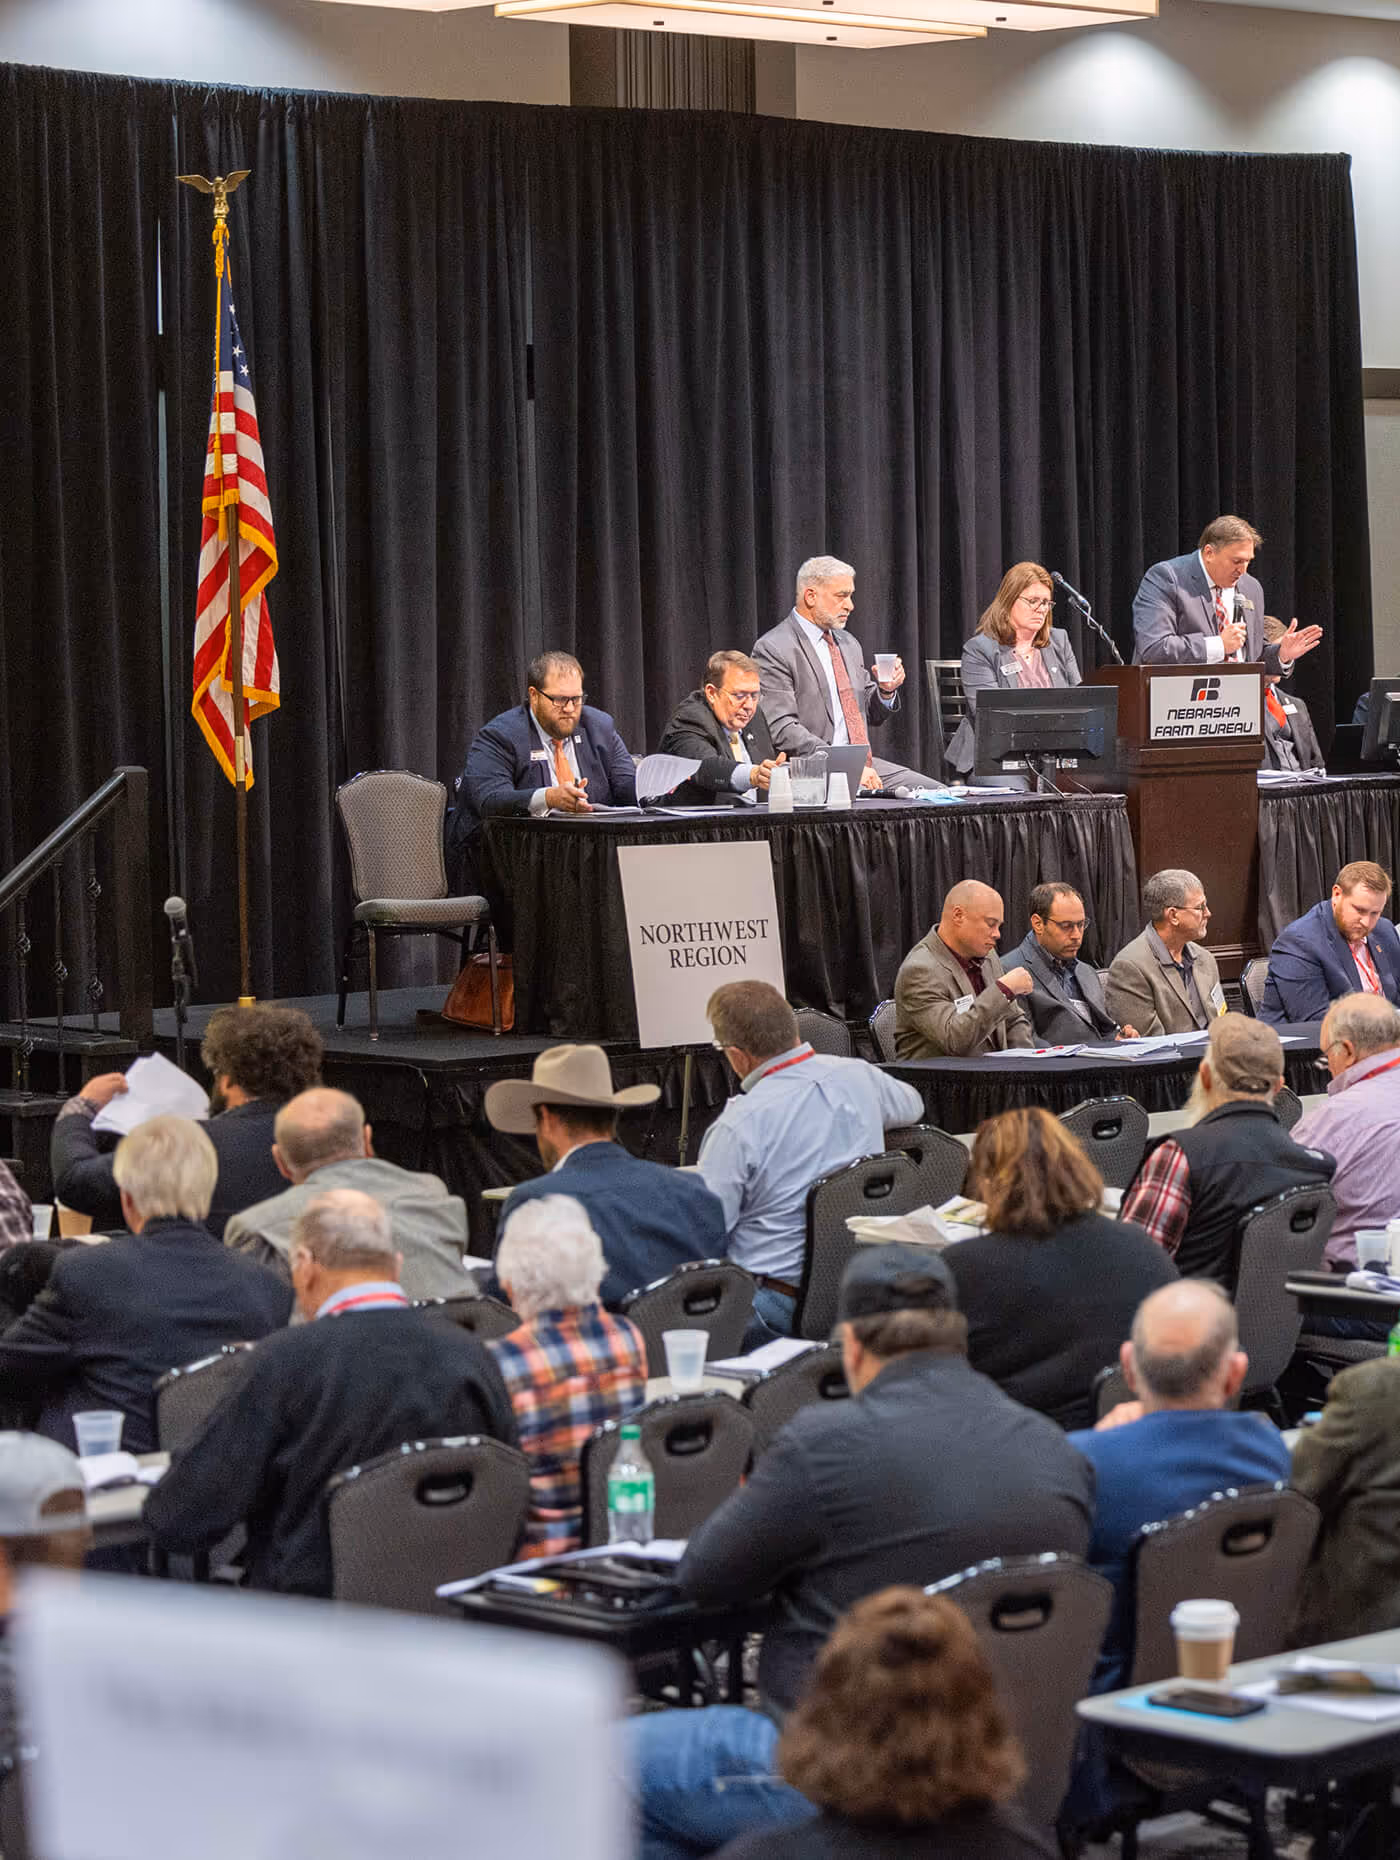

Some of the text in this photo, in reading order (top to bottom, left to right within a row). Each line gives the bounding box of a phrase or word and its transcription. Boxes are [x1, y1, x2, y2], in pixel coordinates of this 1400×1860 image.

[1167, 706, 1241, 720] NEBRASKA
[1155, 722, 1253, 737] FARM BUREAU
[639, 919, 769, 945] NORTHWEST
[668, 945, 747, 969] REGION
